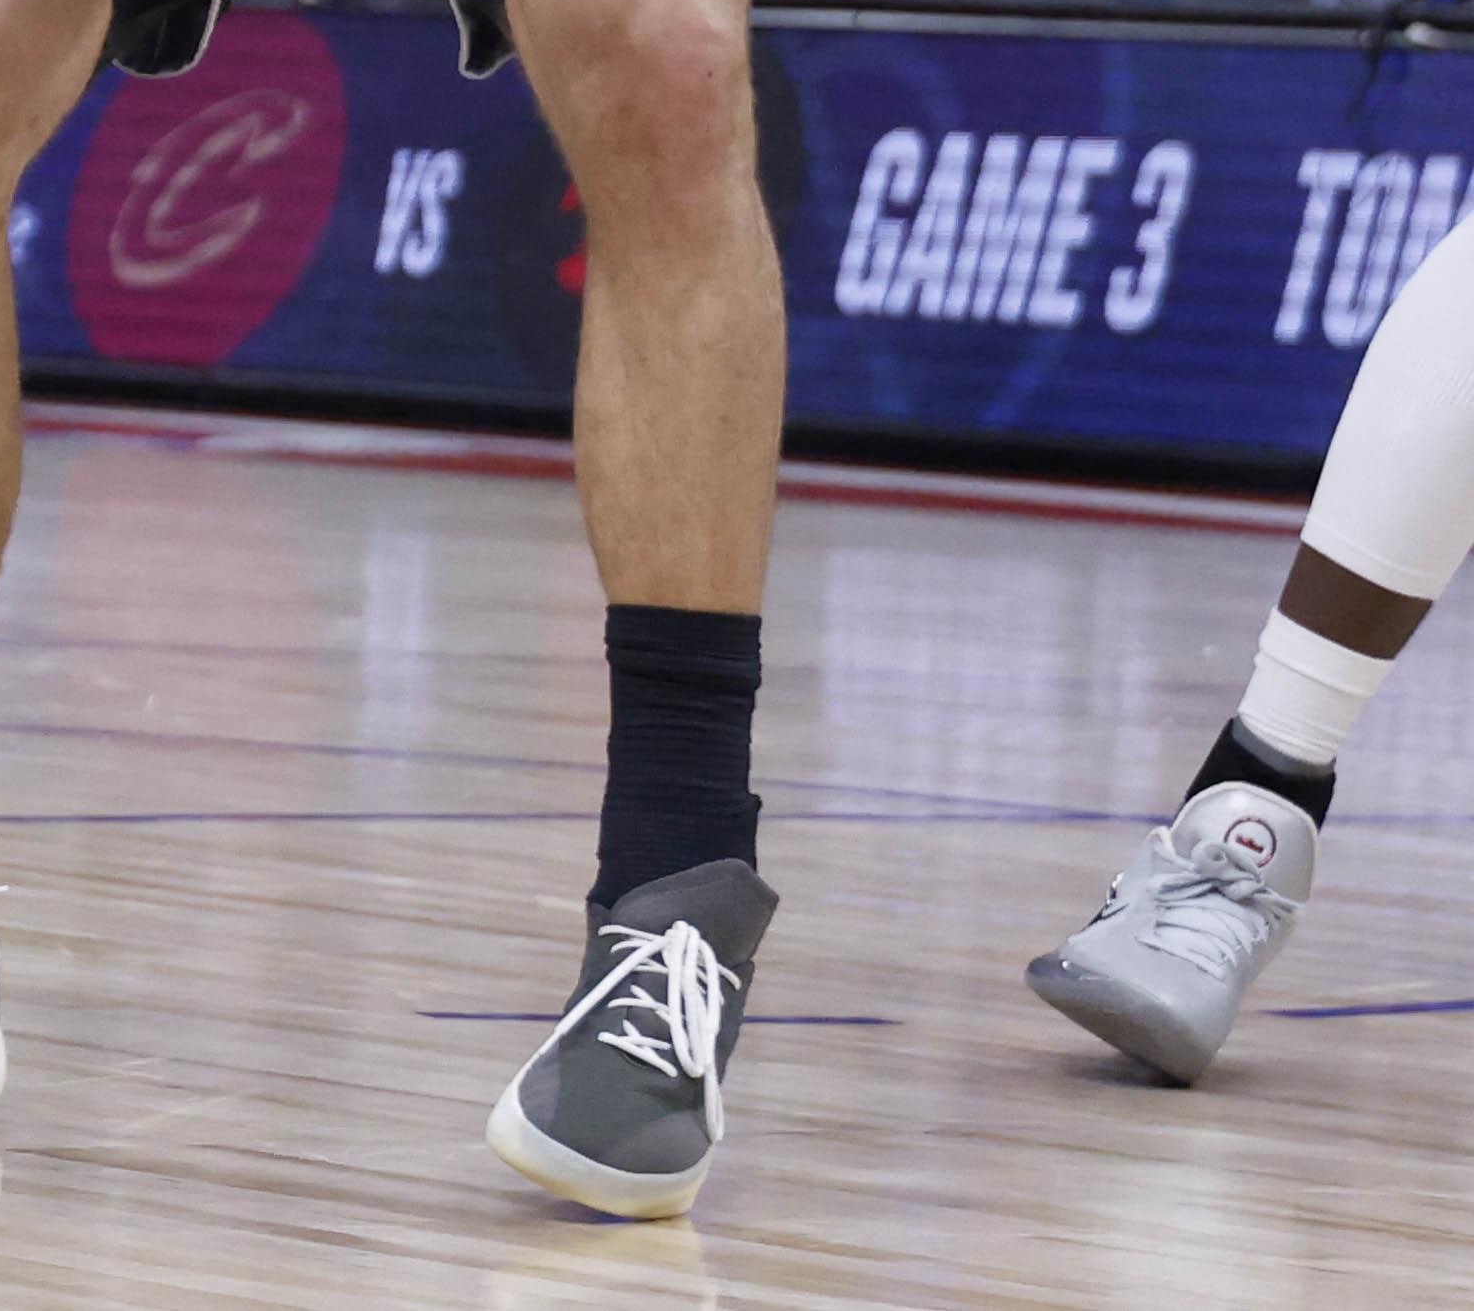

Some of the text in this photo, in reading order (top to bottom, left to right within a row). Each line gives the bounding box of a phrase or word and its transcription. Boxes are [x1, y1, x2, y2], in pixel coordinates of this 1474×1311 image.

[374, 148, 465, 276] VS
[834, 127, 1121, 330] GAME
[1104, 139, 1195, 332] 3
